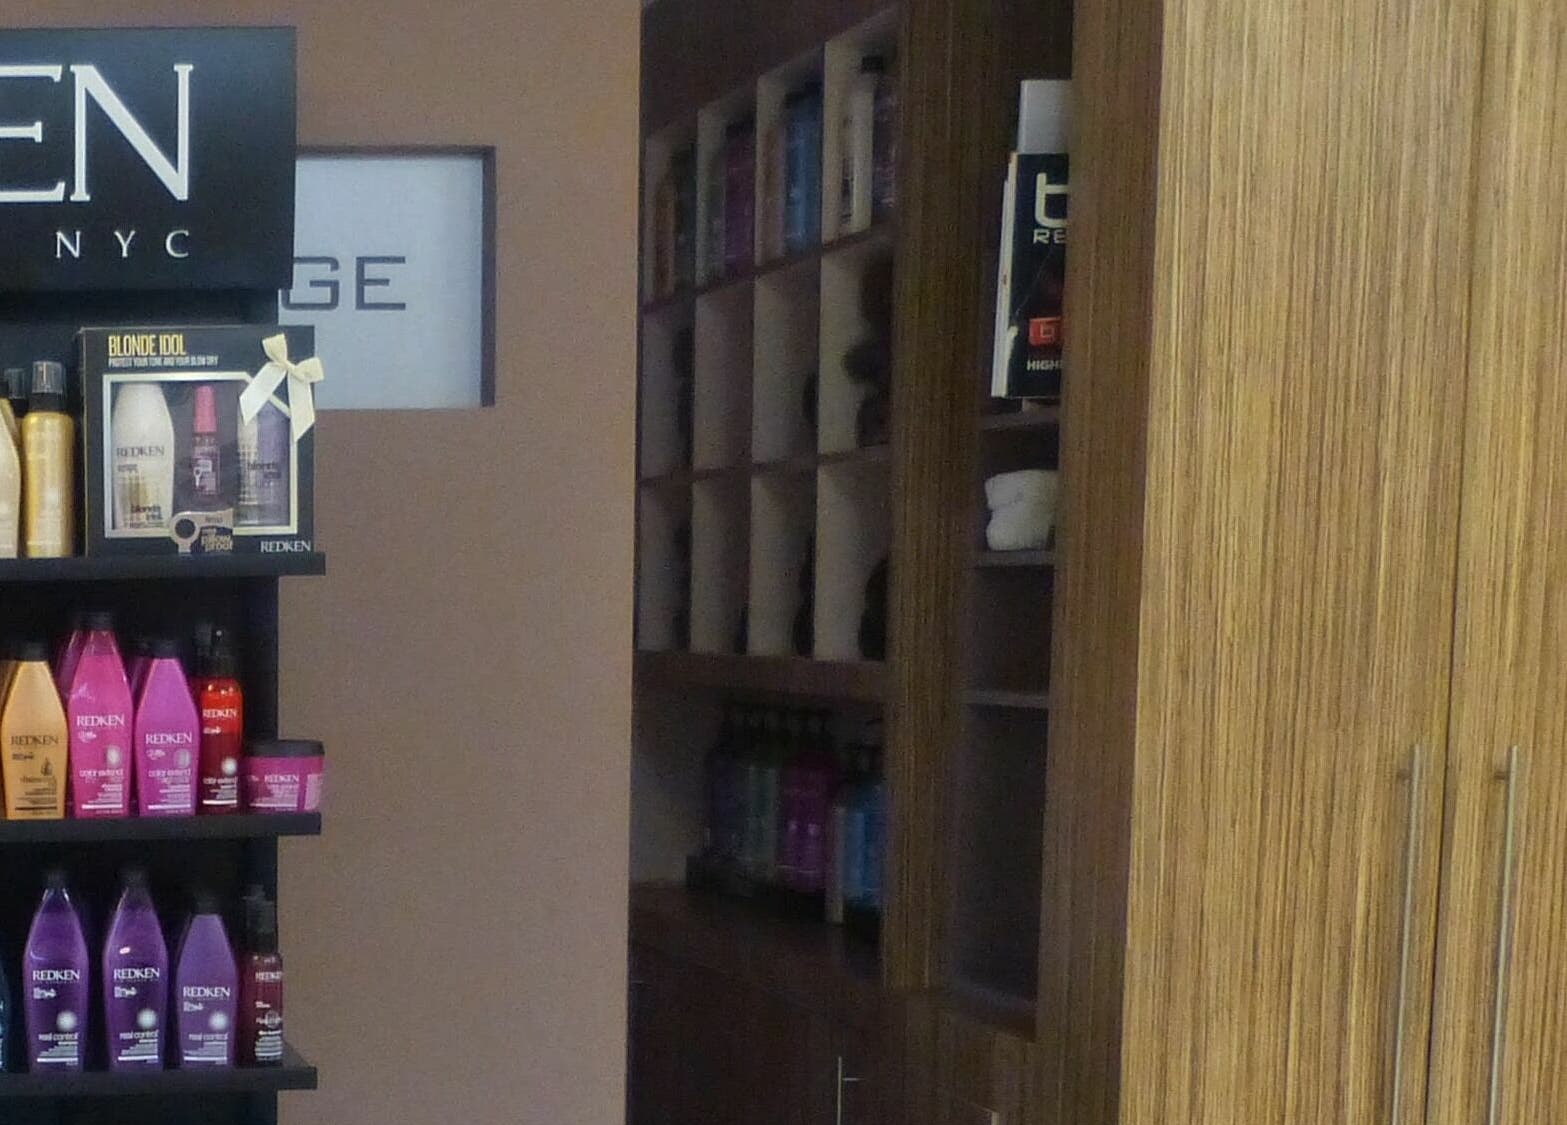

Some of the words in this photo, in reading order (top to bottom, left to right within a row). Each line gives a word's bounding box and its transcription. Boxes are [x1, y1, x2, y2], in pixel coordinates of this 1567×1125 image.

[54, 229, 191, 260] NYC
[108, 335, 157, 357] BLONDE
[159, 334, 187, 356] IDOL
[117, 445, 164, 458] REDKEN
[261, 541, 312, 553] REDKEN
[203, 708, 237, 719] REDKEN
[77, 714, 125, 727] REDKEN
[11, 735, 59, 746] REDKEN
[145, 732, 193, 745] REDKEN
[265, 774, 300, 783] REDKEN
[33, 969, 80, 981] REDKEN
[114, 967, 160, 979] REDKEN
[183, 986, 231, 998] REDKEN
